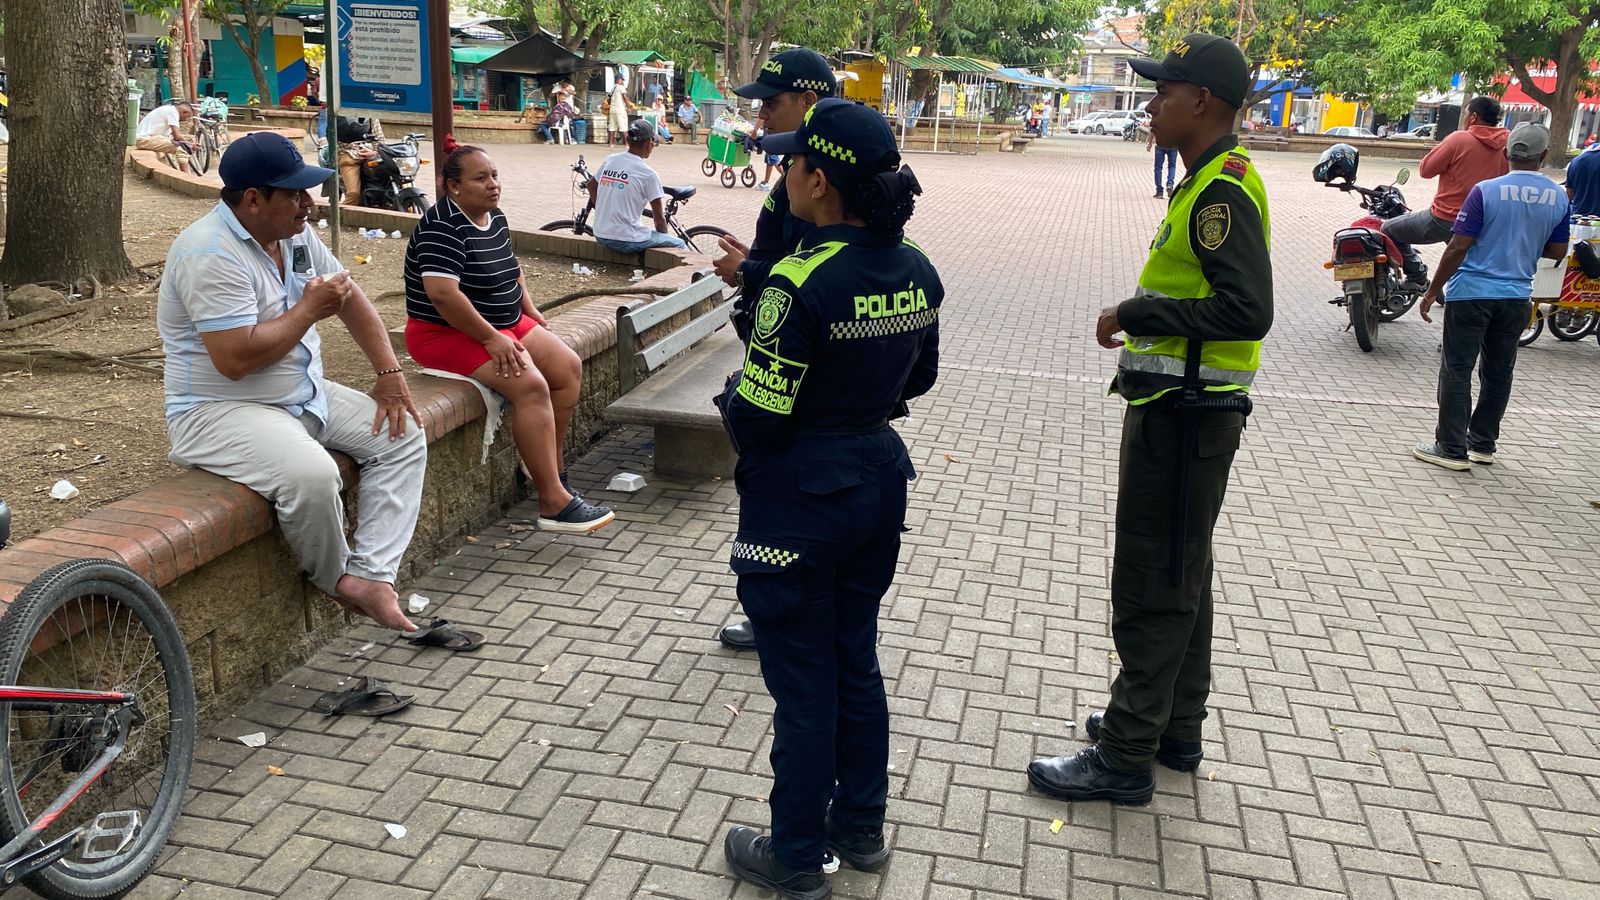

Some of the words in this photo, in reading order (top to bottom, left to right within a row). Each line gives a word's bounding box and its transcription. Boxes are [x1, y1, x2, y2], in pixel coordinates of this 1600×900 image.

[354, 9, 417, 19] ¡BIENVENIDOS!
[602, 169, 628, 180] NUEVO
[1500, 184, 1557, 206] RCA
[764, 290, 787, 304] POLICÍA
[853, 280, 928, 320] POLICÍA
[791, 380, 799, 394] Y
